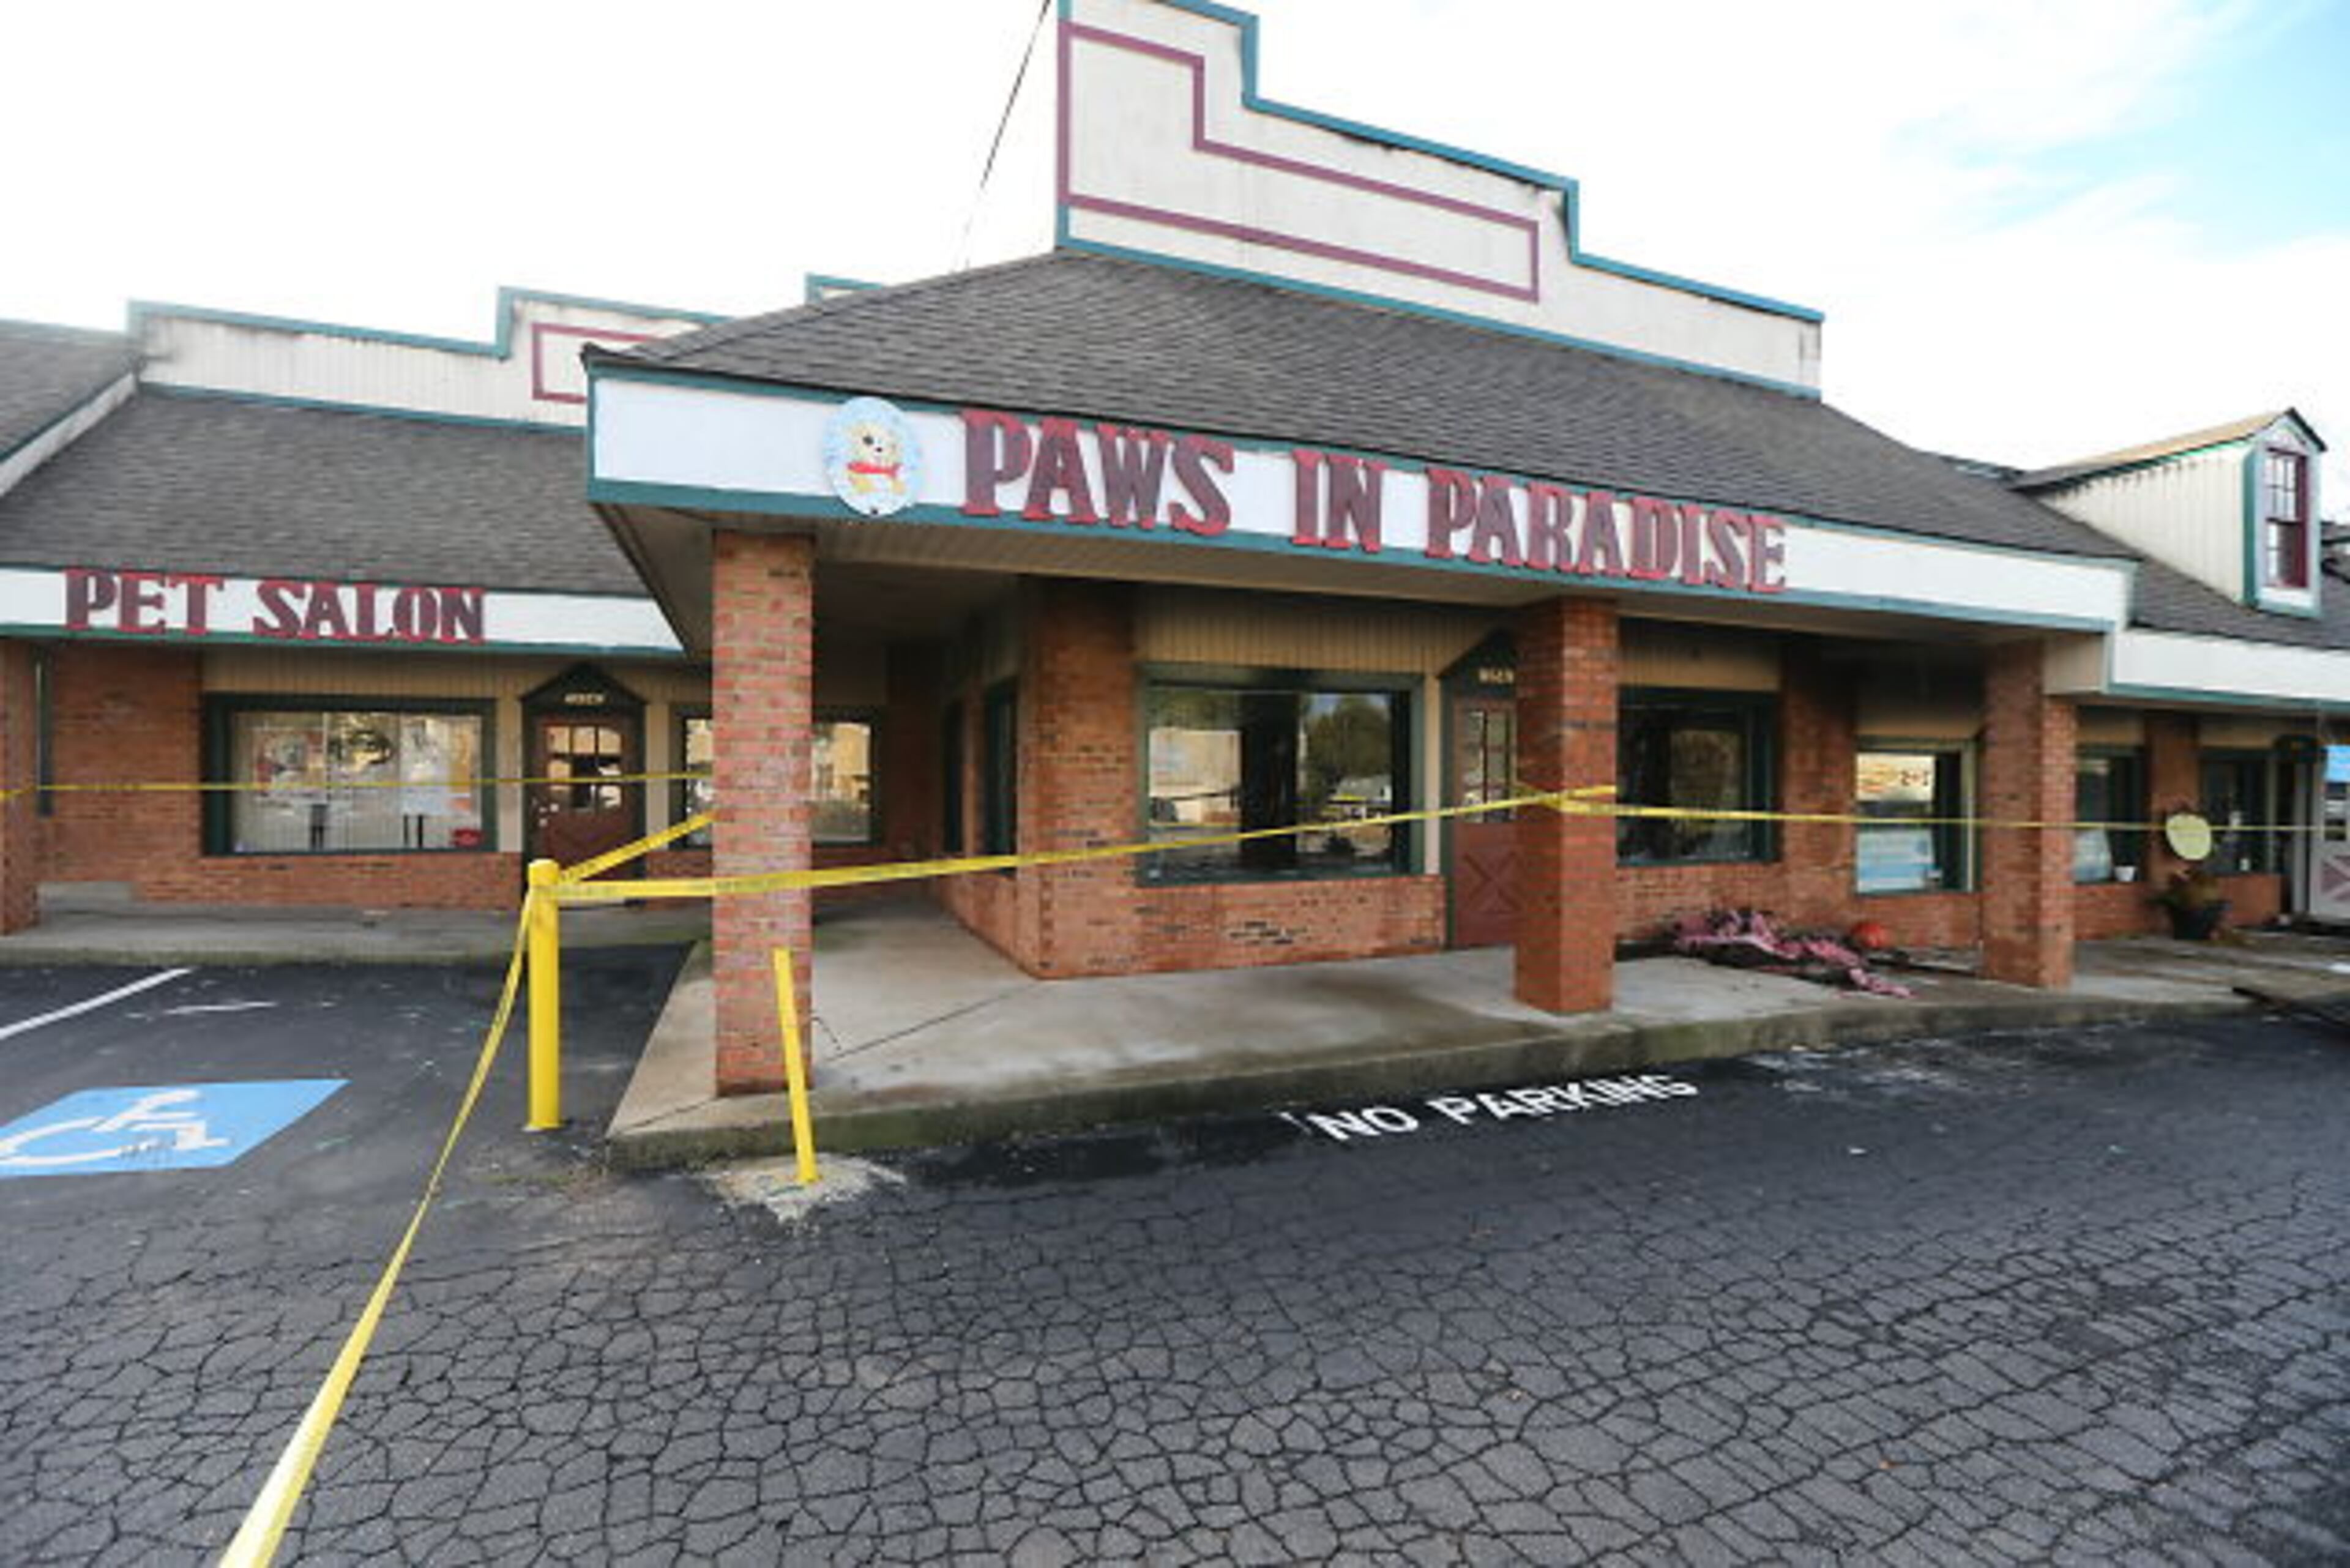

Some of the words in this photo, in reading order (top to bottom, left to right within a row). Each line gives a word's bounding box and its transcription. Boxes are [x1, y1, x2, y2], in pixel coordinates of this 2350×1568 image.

[961, 408, 1234, 537] PAWS
[1292, 449, 1389, 553] IN
[1426, 466, 1786, 592] PARADISE
[63, 569, 225, 636] PET
[252, 579, 488, 644] SALON
[1305, 1107, 1419, 1141] NO
[1427, 1074, 1699, 1124] PARKING
